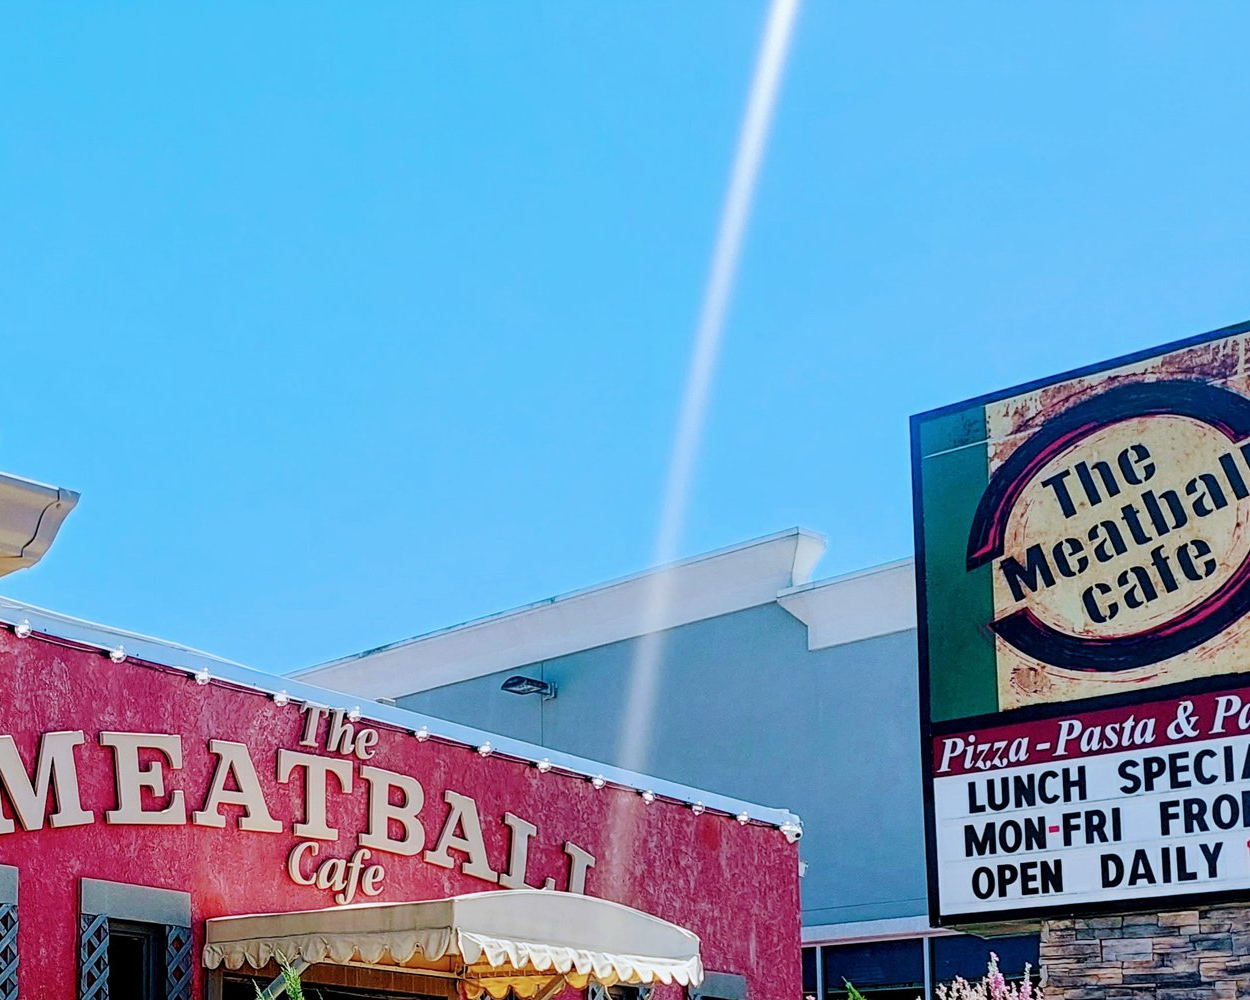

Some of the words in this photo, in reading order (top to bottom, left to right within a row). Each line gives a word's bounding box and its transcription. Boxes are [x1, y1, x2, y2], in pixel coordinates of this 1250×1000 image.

[1042, 443, 1156, 519] The
[300, 701, 379, 760] The
[1166, 700, 1200, 740] &
[968, 765, 1087, 814] LUNCH
[964, 807, 1122, 858] MON-FRI
[1159, 790, 1250, 837] FRO
[288, 841, 385, 905] Cafe
[972, 858, 1063, 900] OPEN
[1100, 842, 1224, 890] DAILY
